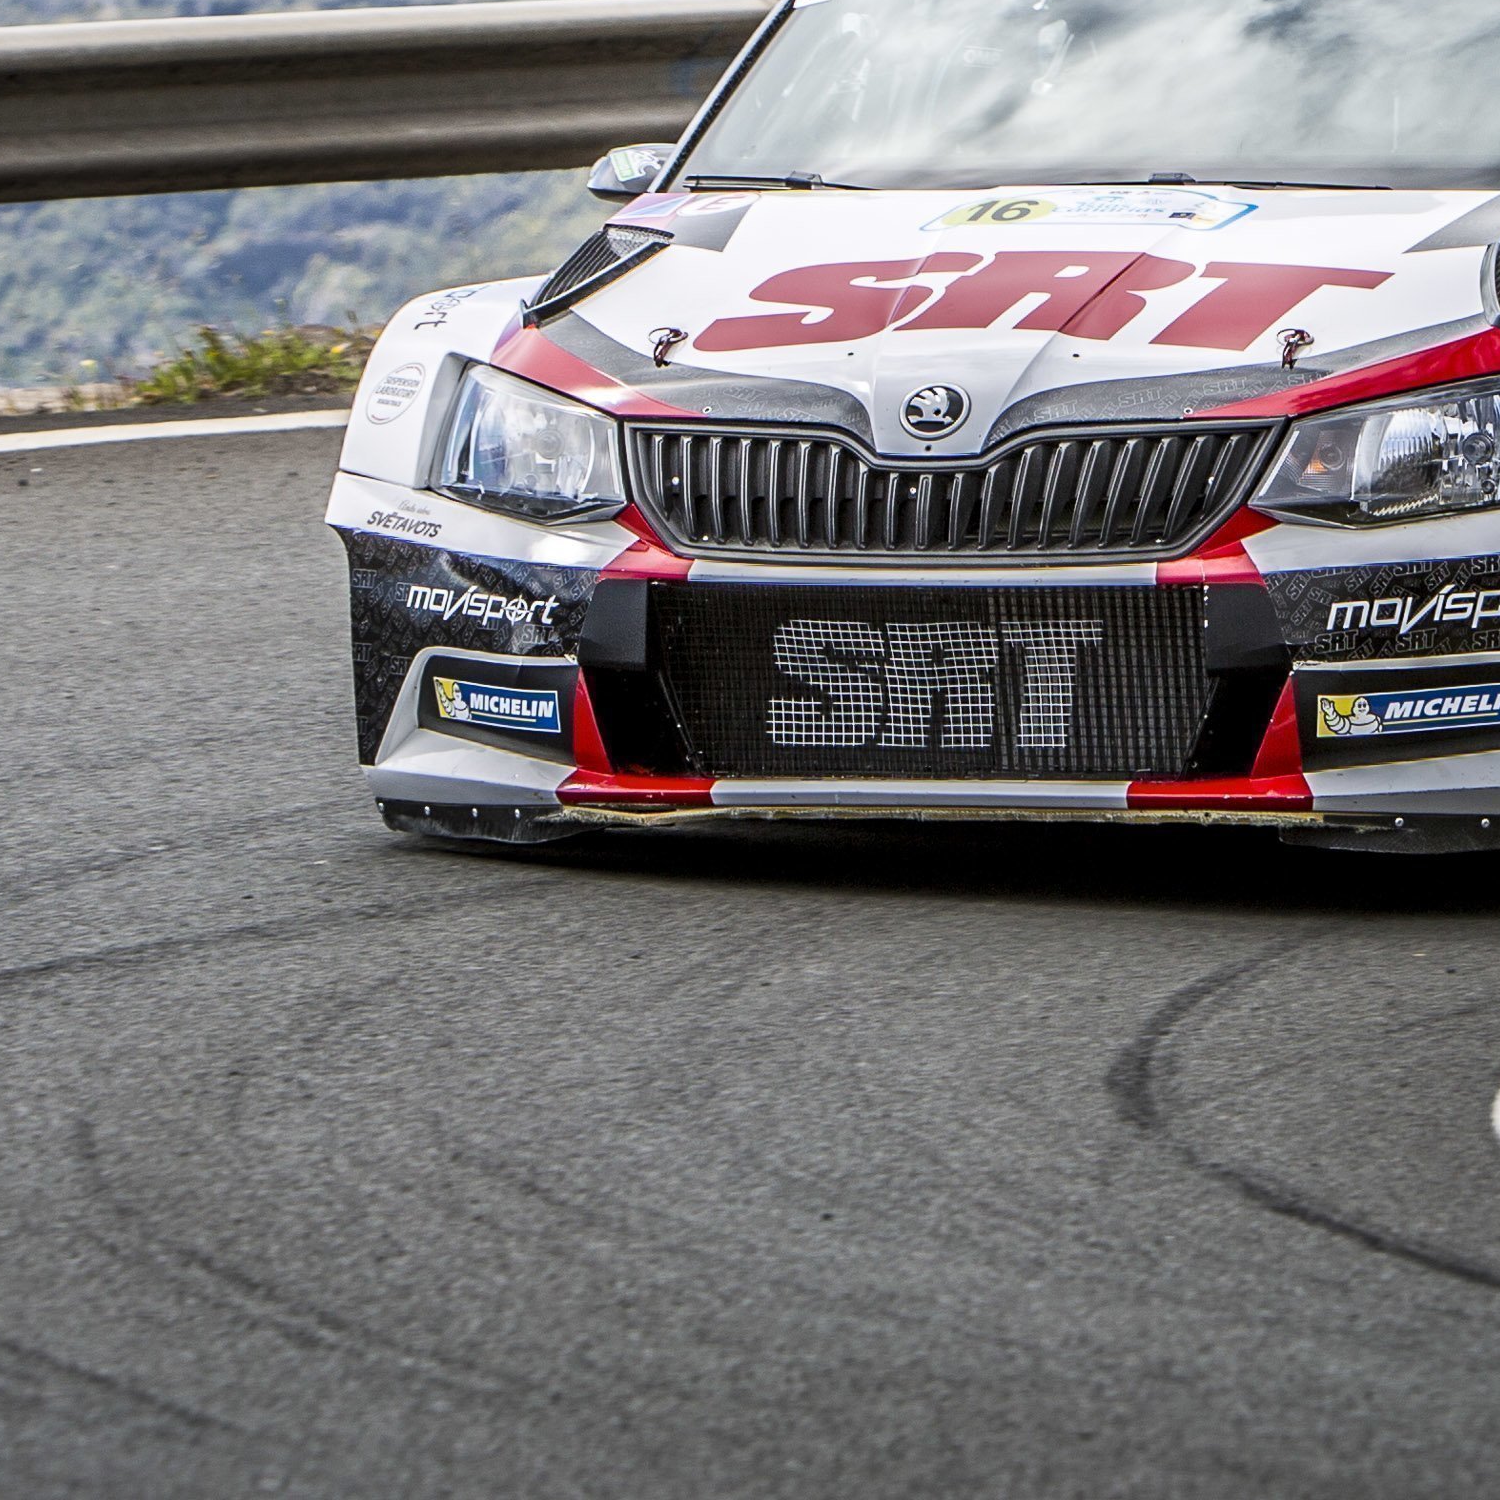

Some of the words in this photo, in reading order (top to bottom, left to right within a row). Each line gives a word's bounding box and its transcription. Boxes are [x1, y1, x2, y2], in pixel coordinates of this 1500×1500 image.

[966, 199, 1040, 222] 16
[693, 250, 1395, 352] SRT
[353, 569, 378, 589] SRT
[406, 585, 560, 626] movisport
[1314, 628, 1360, 654] SRT
[1395, 627, 1438, 653] SRT
[765, 619, 1104, 748] SRT
[470, 692, 555, 718] MICHELIN
